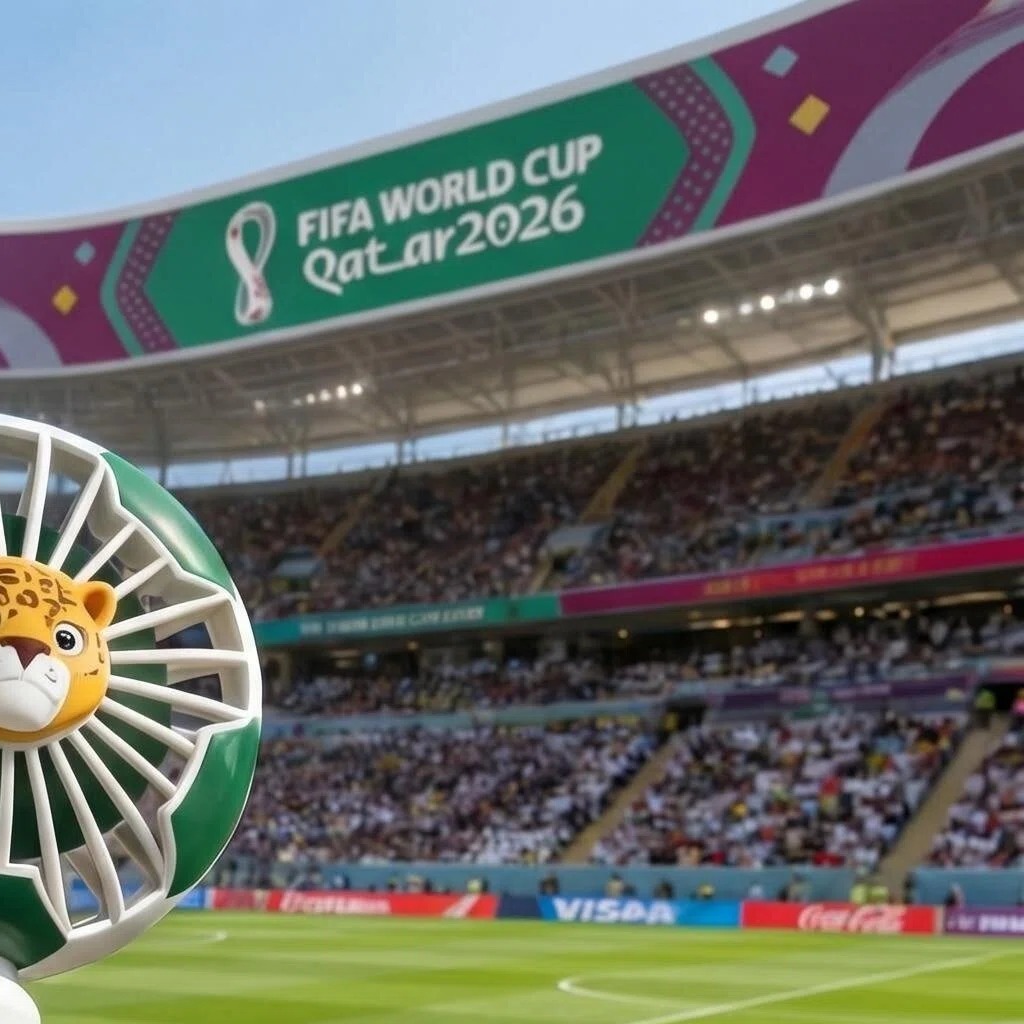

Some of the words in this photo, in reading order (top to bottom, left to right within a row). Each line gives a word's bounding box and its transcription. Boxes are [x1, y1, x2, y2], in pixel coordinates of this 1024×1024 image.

[297, 197, 373, 247] FIFA
[379, 159, 515, 225] WORLD
[522, 133, 603, 187] CUP
